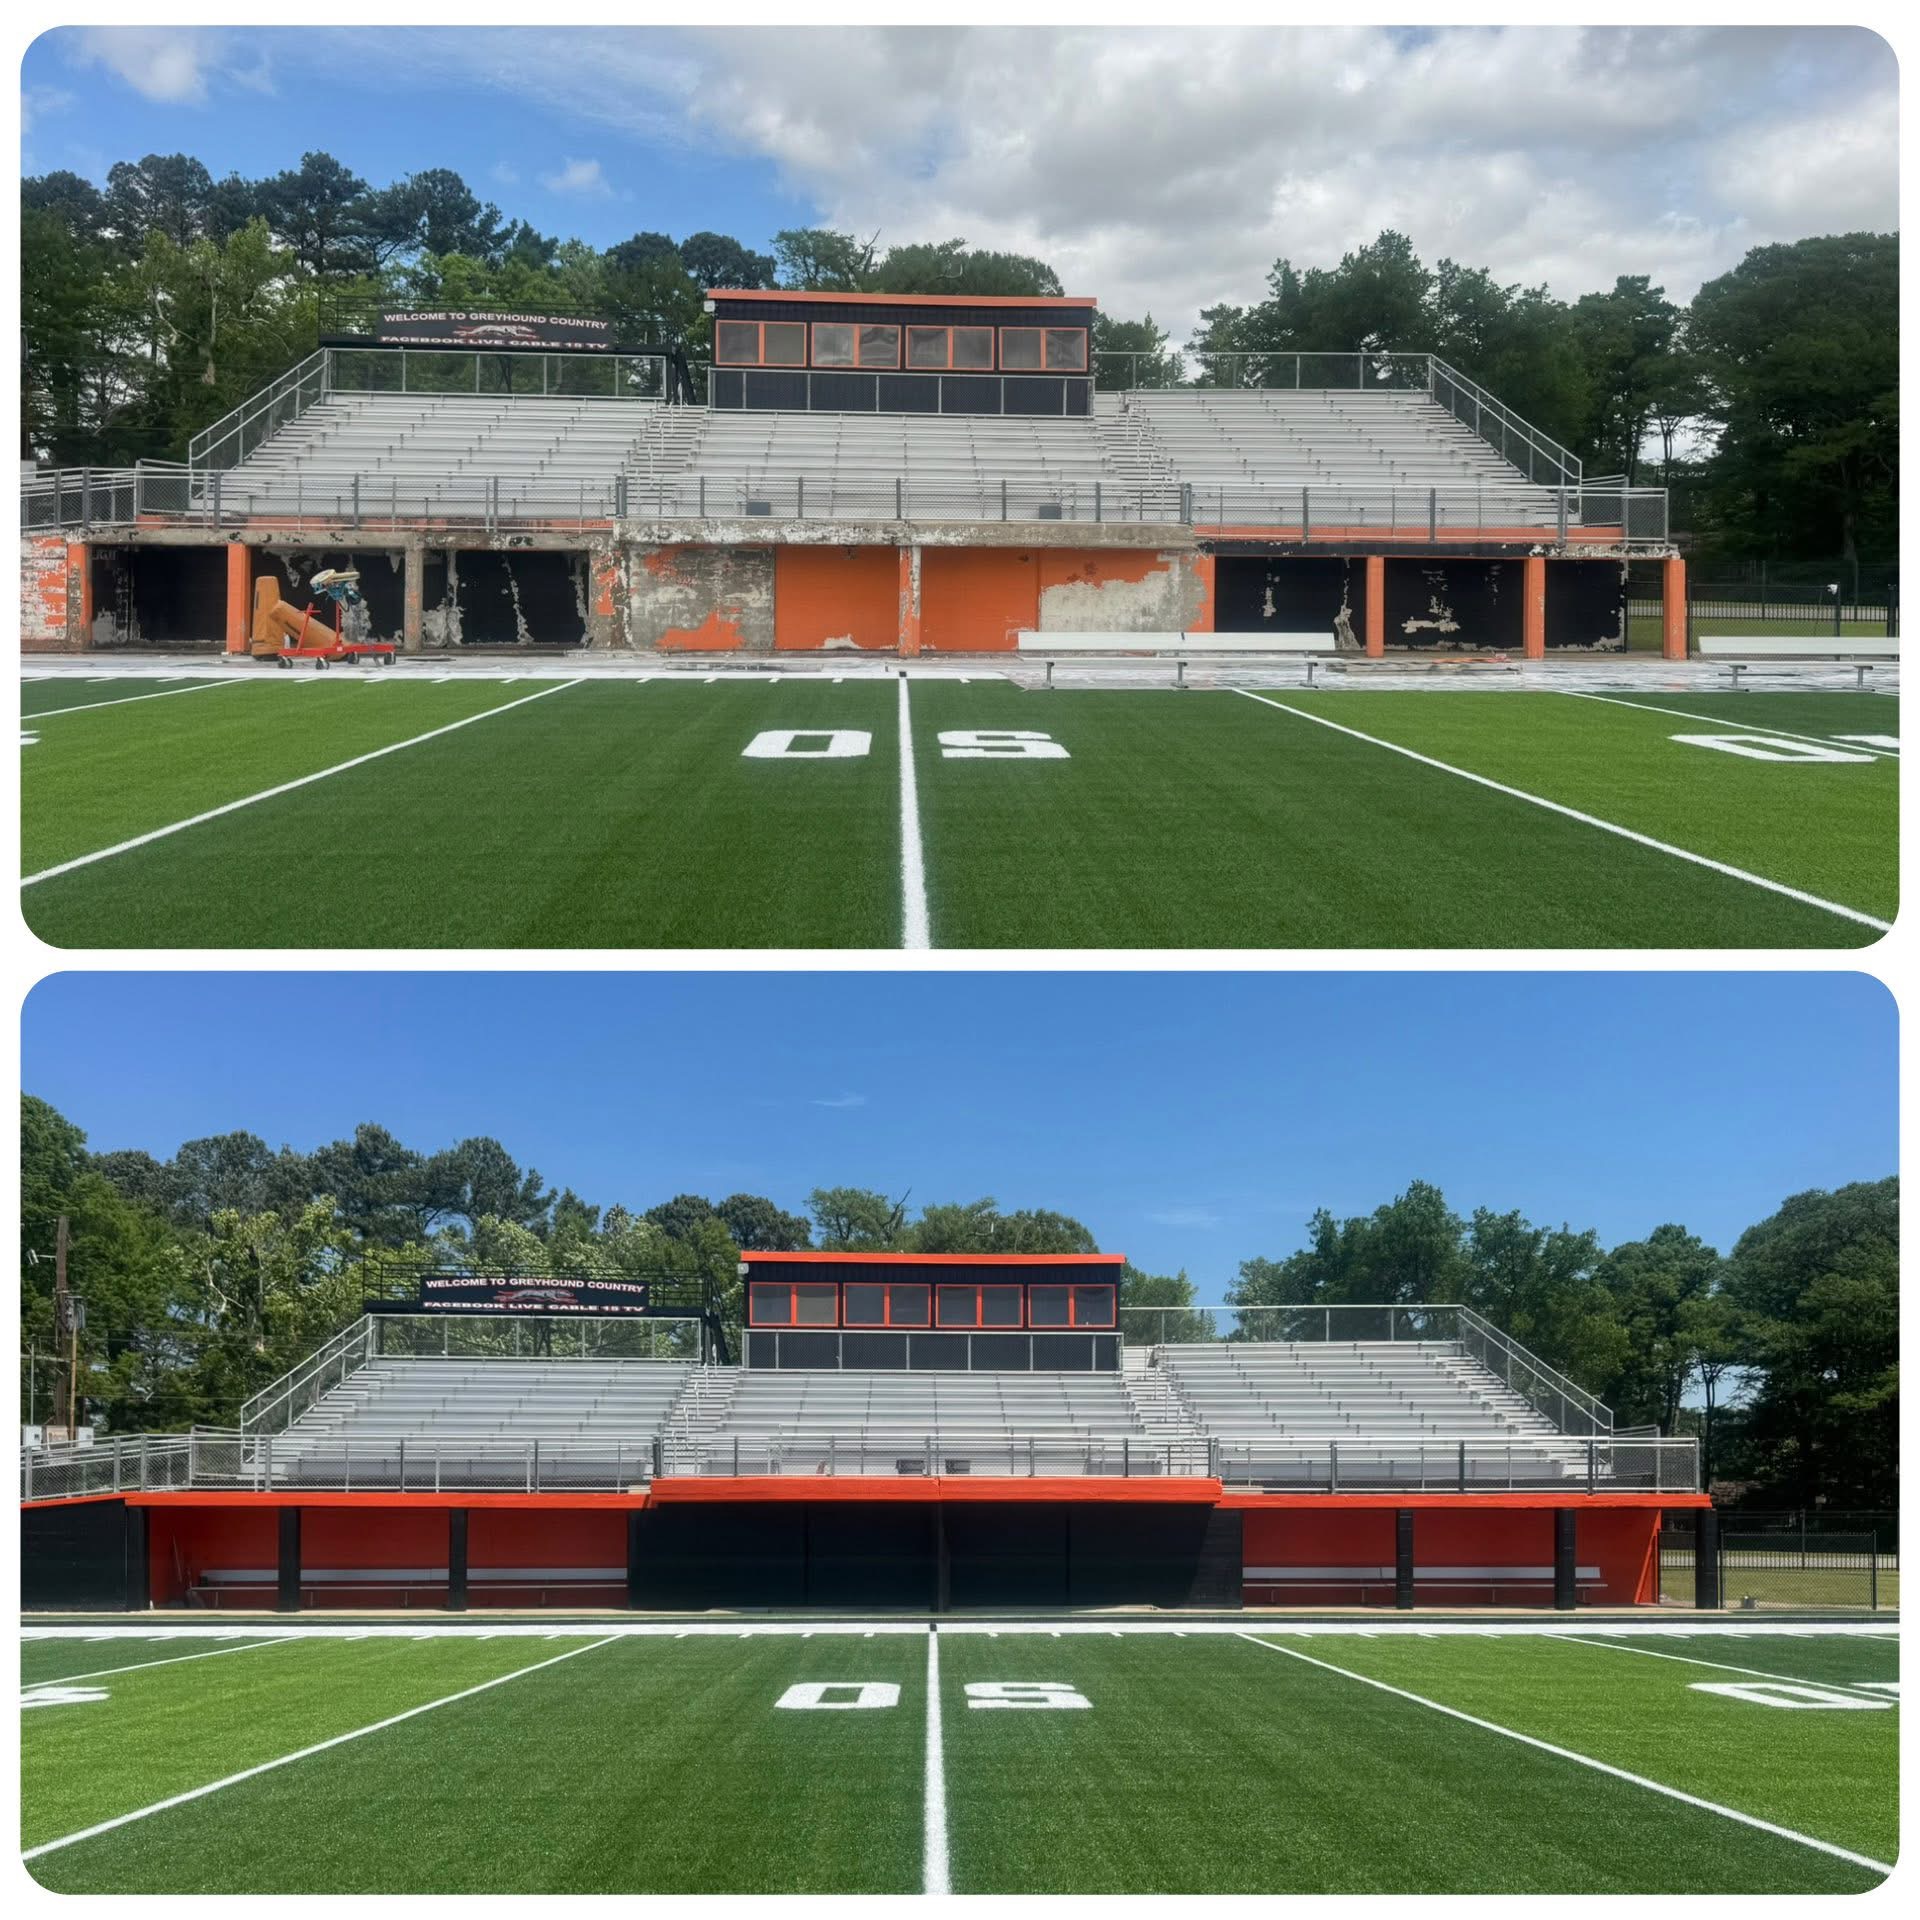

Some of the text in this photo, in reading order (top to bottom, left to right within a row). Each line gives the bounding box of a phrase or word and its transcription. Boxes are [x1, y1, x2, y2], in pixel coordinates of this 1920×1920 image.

[384, 312, 608, 329] WELCOME TO GREYHOUND COUNTRY
[381, 336, 463, 344] FACEBOOK
[426, 1278, 645, 1293] WELCOME TO GREYHOUND COUNTRY
[423, 1301, 504, 1309] FACEBOOK
